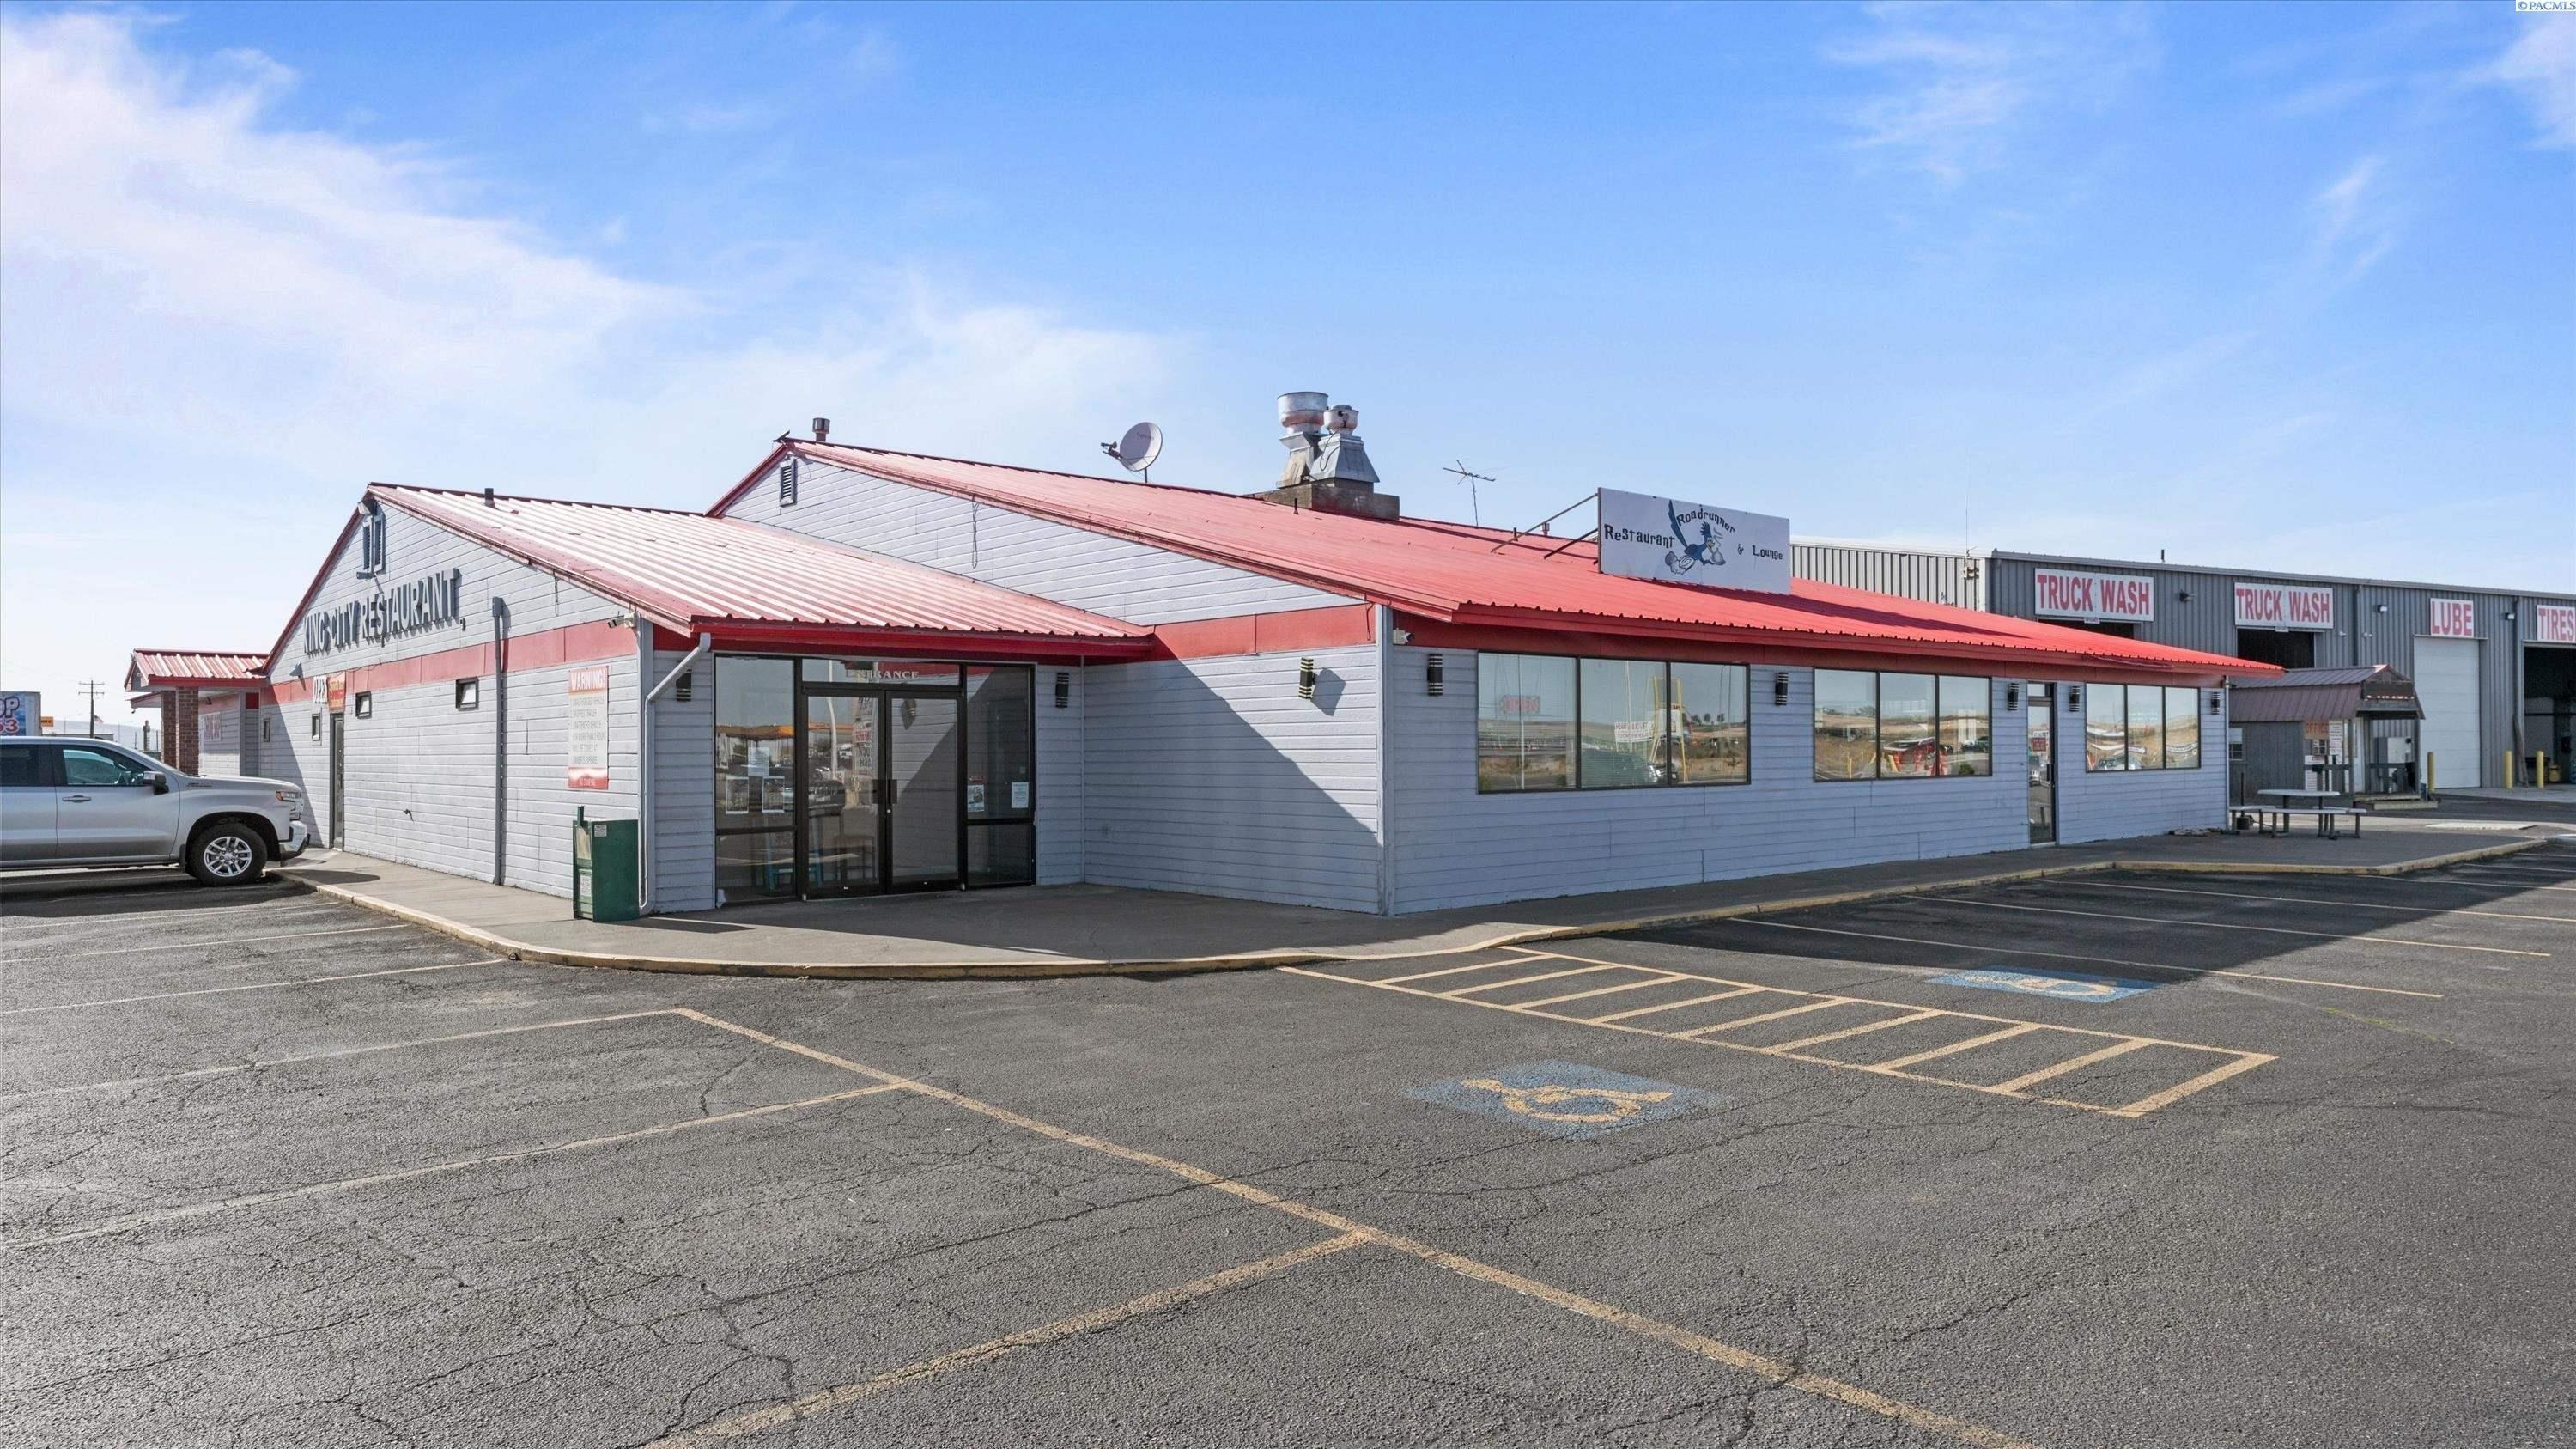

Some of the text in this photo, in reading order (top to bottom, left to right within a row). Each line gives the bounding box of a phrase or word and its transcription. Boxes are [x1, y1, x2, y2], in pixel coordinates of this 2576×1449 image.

[1676, 508, 1735, 534] Roadrunner
[1604, 524, 1783, 560] Restaurant & Lounge
[304, 568, 461, 654] KING CITY RESTAURANT
[2038, 575, 2149, 615] TRUCK WASH
[2236, 588, 2330, 623] TRUCK WASH
[2432, 601, 2472, 636] LUBE
[2538, 608, 2574, 641] TIRES
[570, 669, 605, 691] WARNING!
